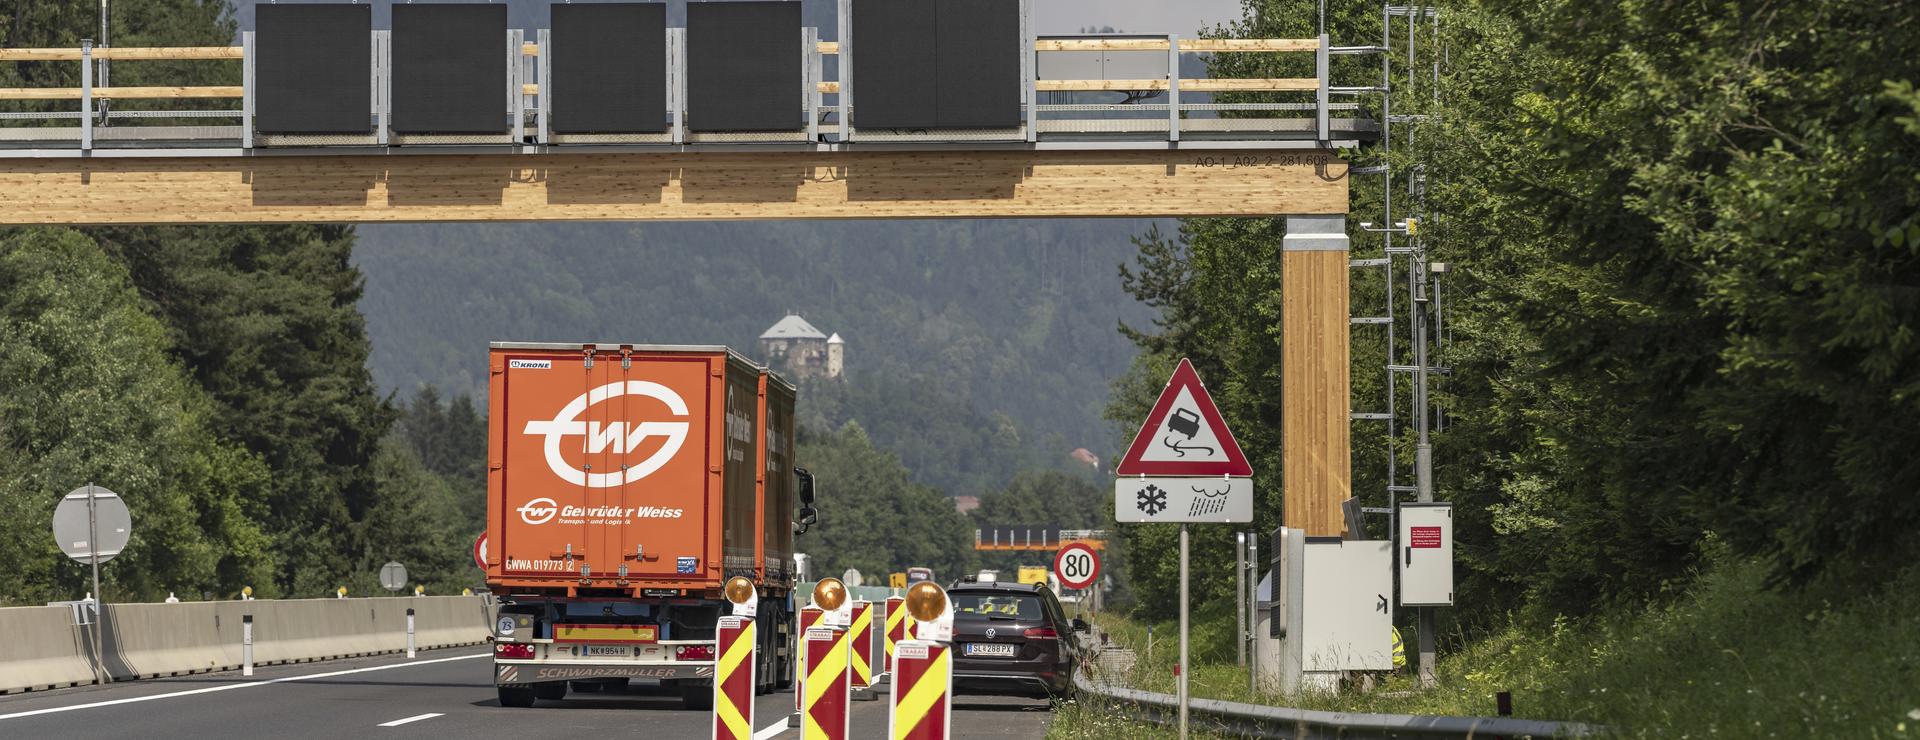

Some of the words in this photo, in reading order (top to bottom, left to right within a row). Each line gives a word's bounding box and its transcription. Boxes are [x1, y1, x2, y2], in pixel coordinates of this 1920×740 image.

[637, 506, 683, 518] Weiss
[506, 559, 531, 570] GWWA
[534, 560, 563, 570] 019773
[1066, 554, 1090, 577] 80
